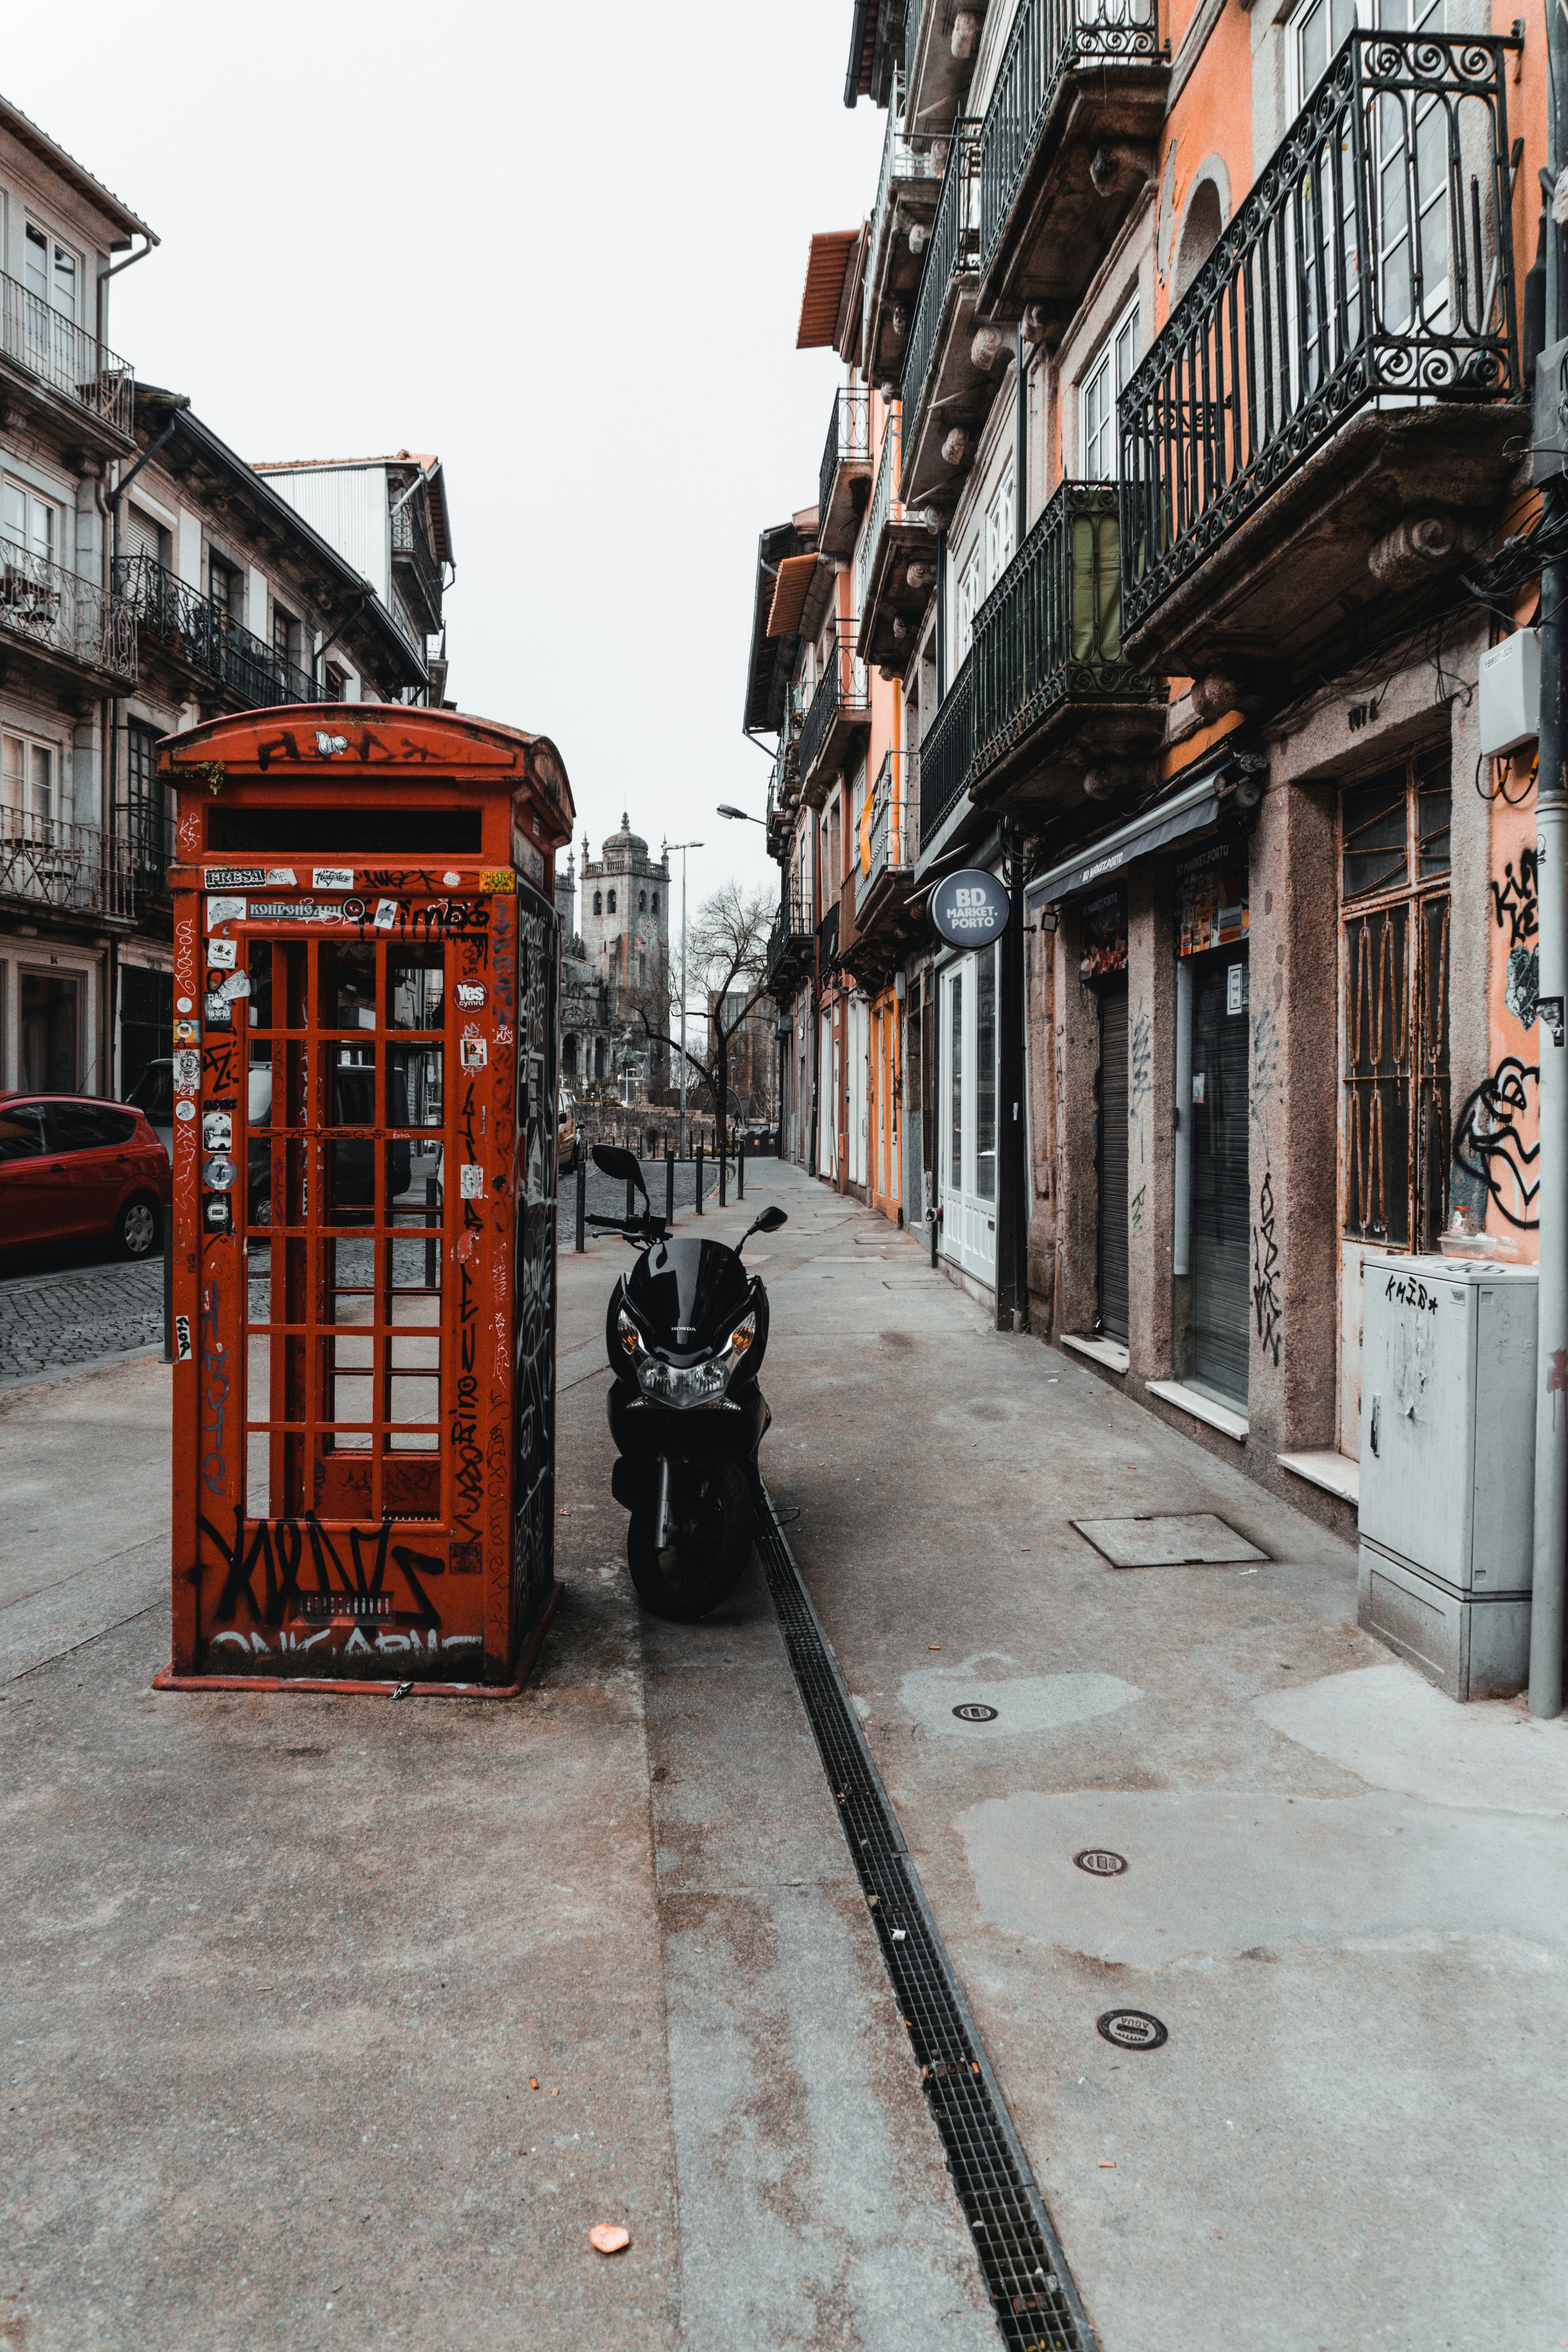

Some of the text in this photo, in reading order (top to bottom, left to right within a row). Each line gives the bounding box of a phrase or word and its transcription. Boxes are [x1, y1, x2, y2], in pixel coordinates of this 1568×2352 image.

[1082, 869, 1090, 882] BD
[1176, 864, 1183, 877] BD
[207, 870, 264, 885] FRESA
[956, 888, 986, 907] BD
[1082, 906, 1088, 916] BD
[951, 917, 994, 929] PORTO
[457, 984, 484, 1001] Yes
[1108, 1857, 1117, 1869] AGUA
[1121, 2017, 1149, 2029] AGUA
